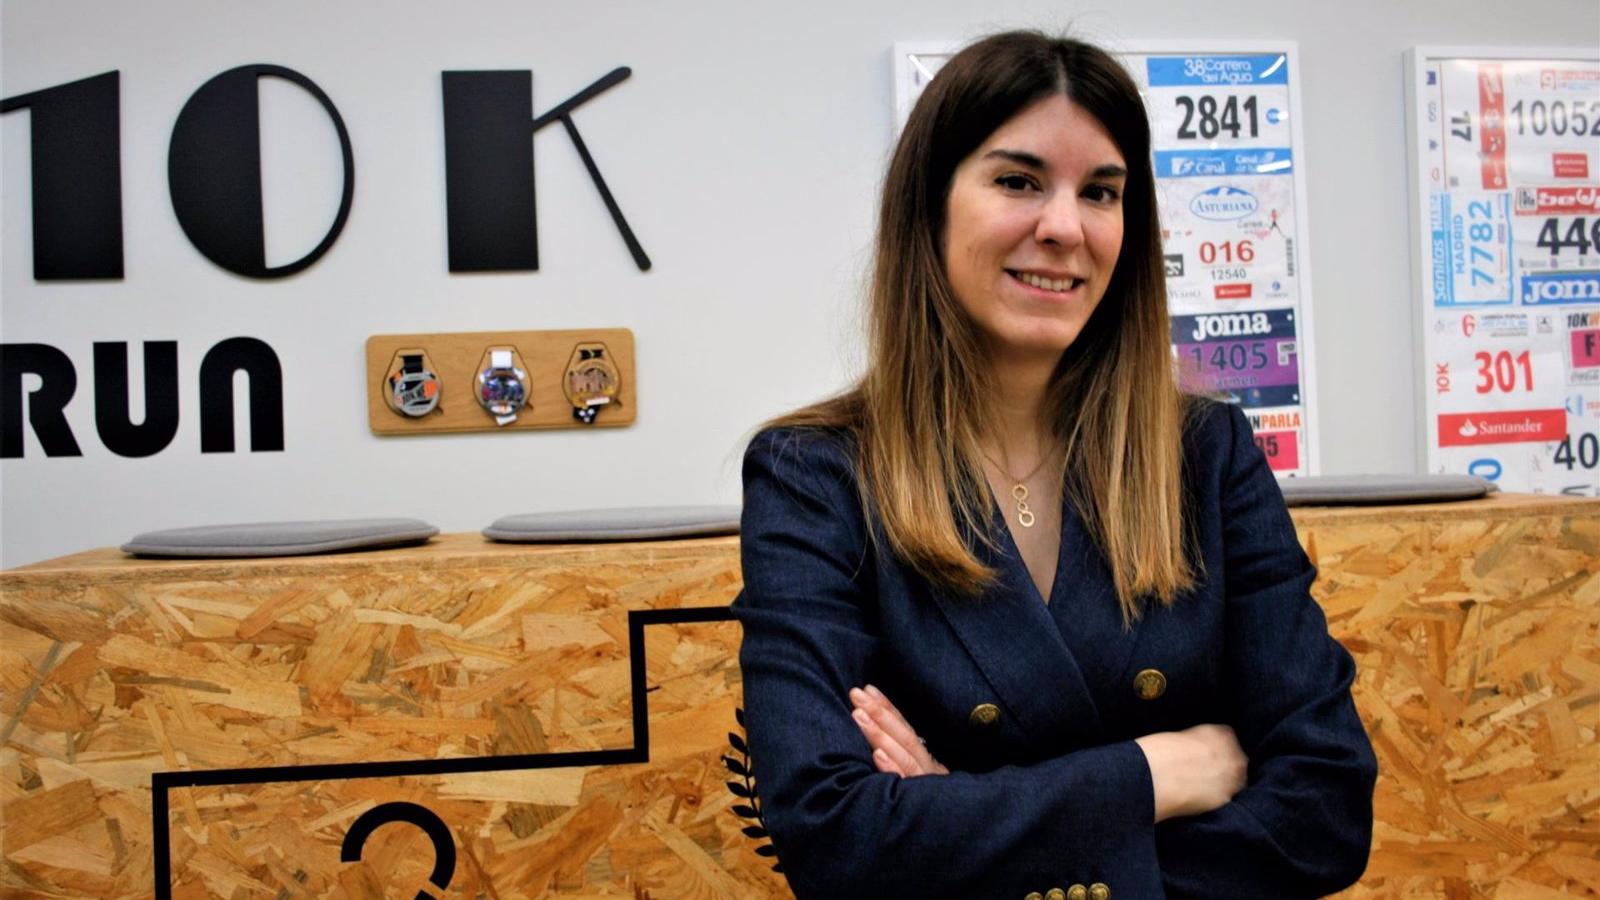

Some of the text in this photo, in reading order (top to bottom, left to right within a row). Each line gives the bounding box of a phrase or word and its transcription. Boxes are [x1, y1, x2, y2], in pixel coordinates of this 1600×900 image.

[1184, 59, 1251, 76] 38 Carrera
[1221, 73, 1253, 85] Agua
[1175, 95, 1259, 140] 2841
[1511, 100, 1600, 136] 10052
[1200, 240, 1254, 264] 016
[1454, 215, 1465, 274] MADRID
[1468, 201, 1495, 287] 7782
[1211, 269, 1247, 280] 12540
[1462, 314, 1475, 337] 6
[1191, 343, 1268, 373] 1405
[1475, 351, 1533, 394] 301
[1436, 362, 1450, 394] 10K
[1480, 418, 1543, 435] Santander
[1553, 432, 1600, 470] 40
